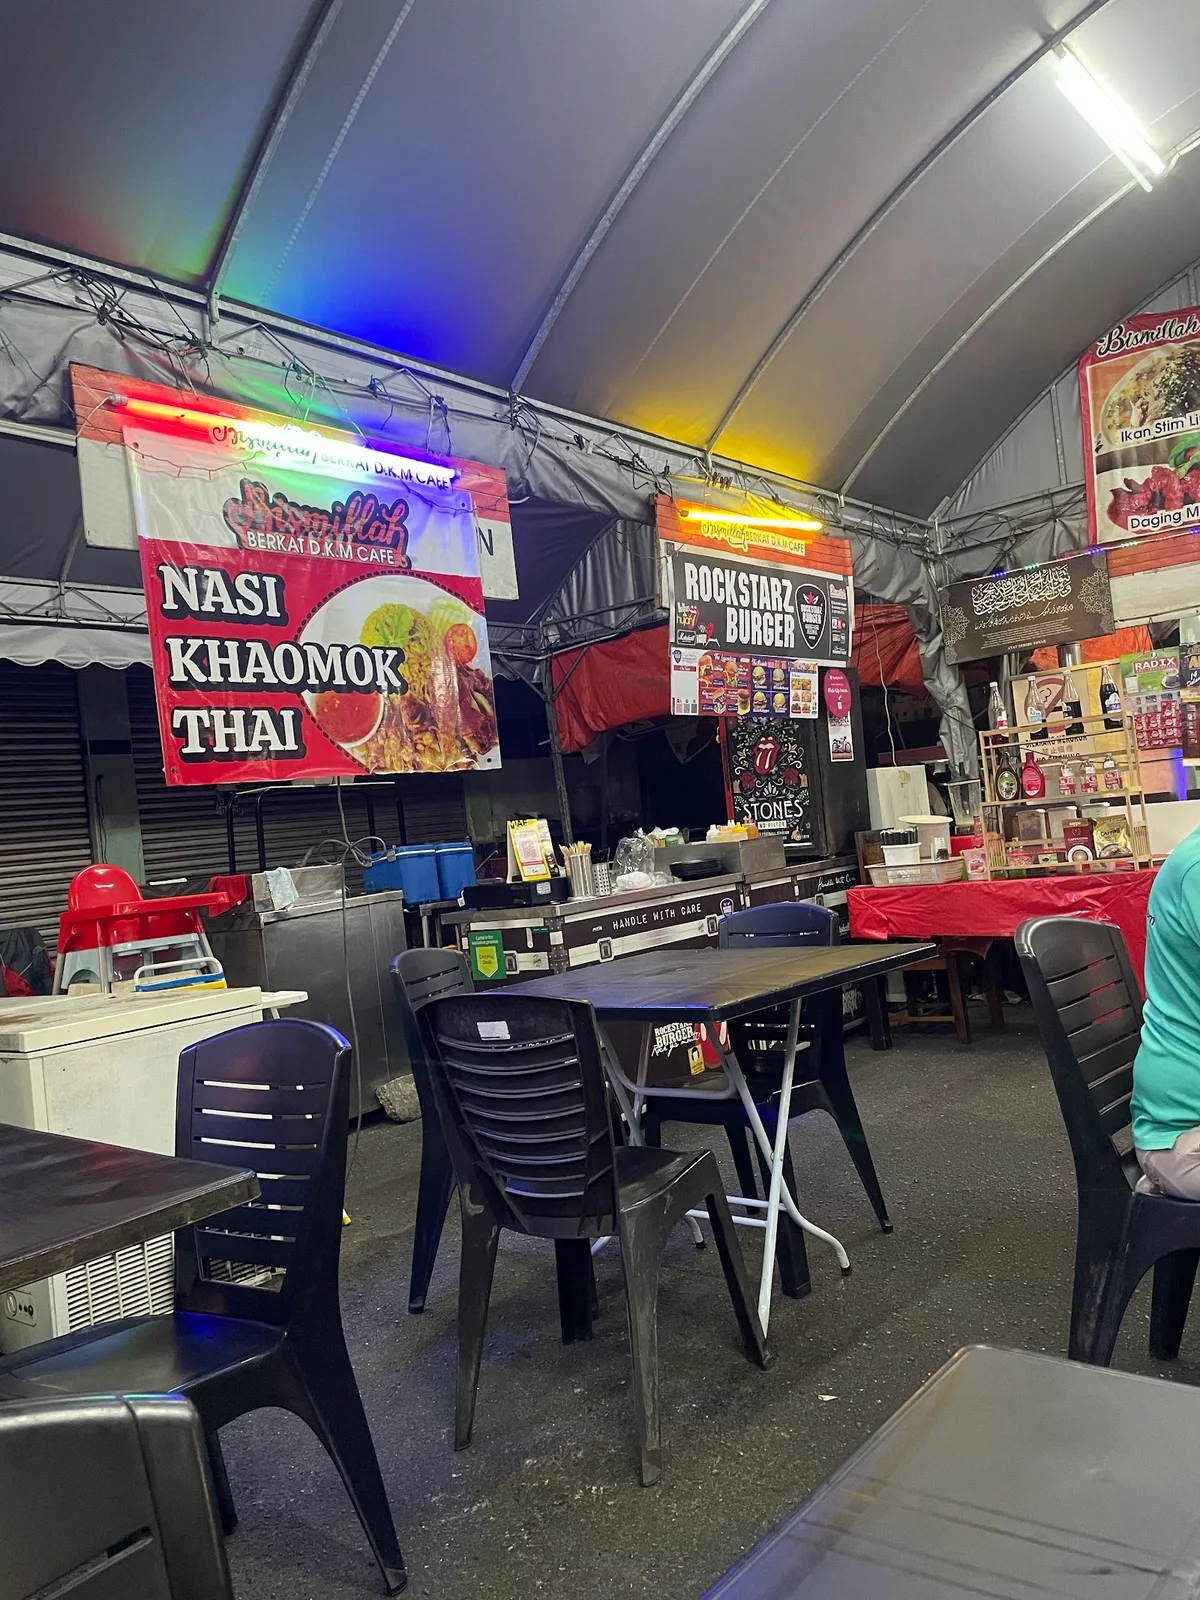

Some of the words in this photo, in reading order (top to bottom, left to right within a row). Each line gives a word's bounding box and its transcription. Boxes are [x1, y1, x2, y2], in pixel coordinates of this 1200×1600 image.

[1097, 314, 1200, 356] Bismillah
[1121, 429, 1151, 443] Ikan
[1155, 419, 1184, 434] Stim
[1189, 413, 1200, 426] Li
[374, 460, 413, 482] D.K.M
[415, 471, 449, 489] CAFE
[224, 480, 410, 549] Bismillah
[1131, 511, 1182, 531] Daging
[247, 531, 304, 553] BERKAT
[310, 541, 354, 560] D.K.M
[357, 547, 394, 565] CAFE
[746, 531, 771, 546] BERKAT
[789, 542, 804, 554] CAFE
[158, 565, 281, 618] NASI
[684, 562, 794, 614] ROCKSTARZ
[801, 604, 823, 614] ROCKSTARZ
[803, 612, 822, 625] BURGER
[726, 607, 795, 649] BURGER
[166, 638, 402, 687] KHAOMOK
[1134, 657, 1176, 671] RADIX
[173, 709, 299, 755] THAI
[743, 800, 804, 820] STONES
[613, 914, 648, 930] HANDLE
[653, 908, 676, 921] WITH
[680, 903, 702, 916] CARE
[655, 1026, 694, 1048] BURGER
